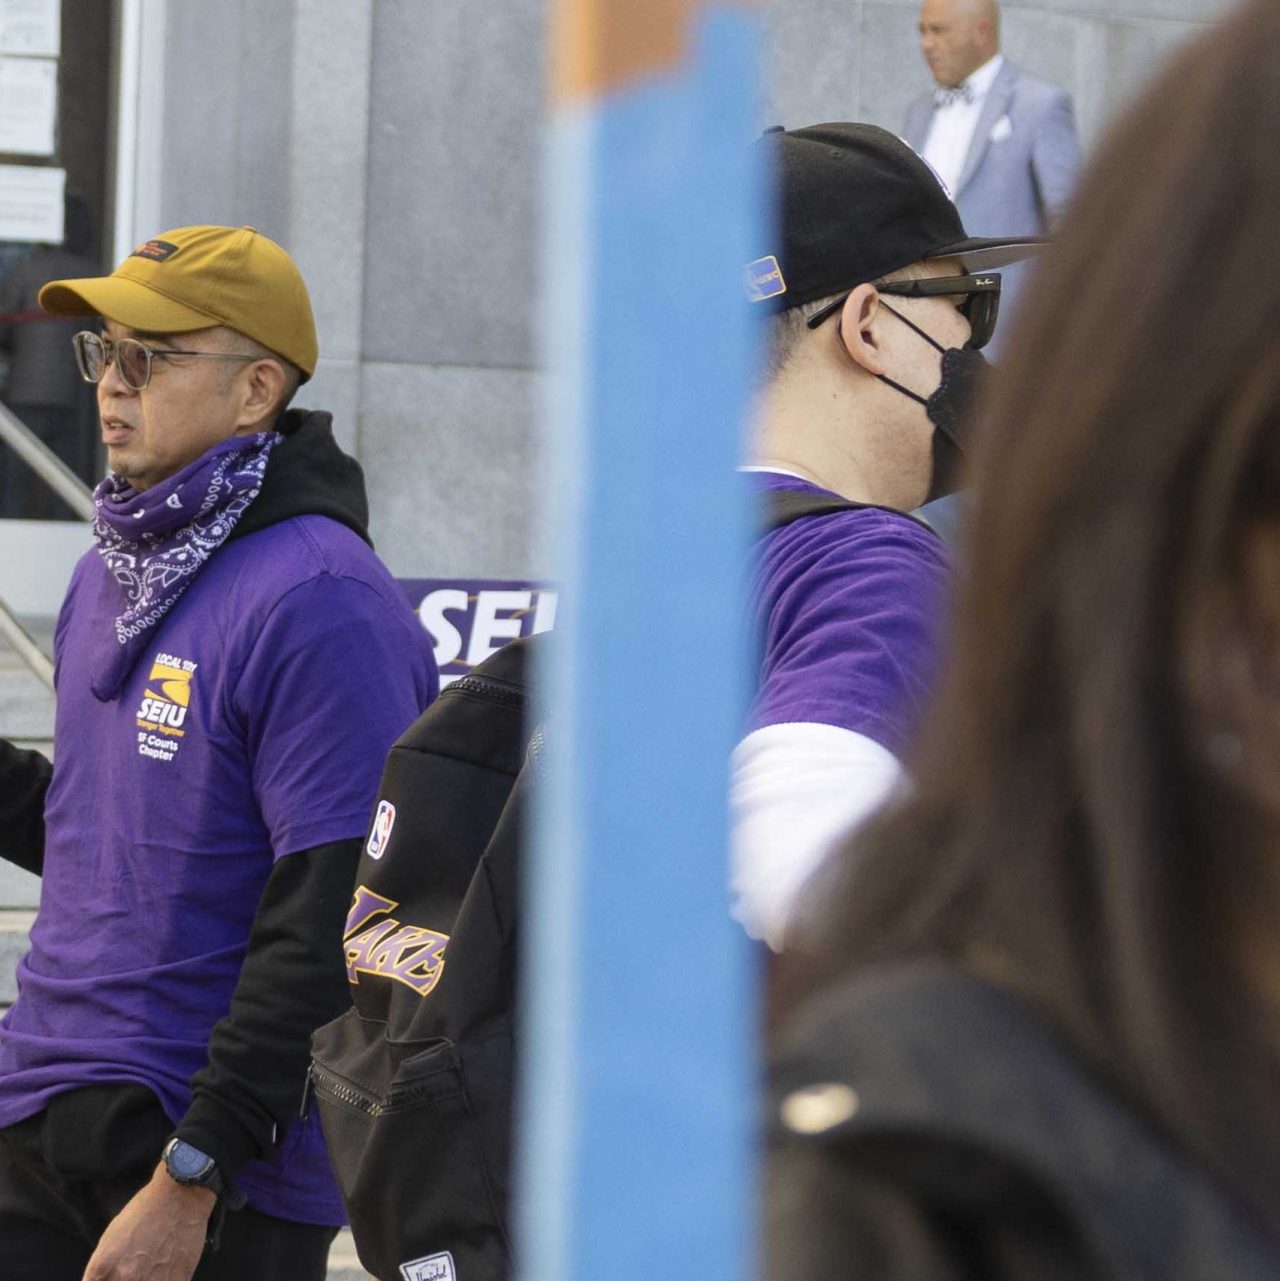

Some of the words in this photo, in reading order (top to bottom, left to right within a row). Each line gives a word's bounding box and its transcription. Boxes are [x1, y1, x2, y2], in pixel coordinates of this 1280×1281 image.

[419, 589, 558, 666] SEI
[155, 653, 182, 669] LOCAL
[136, 698, 187, 727] SEIU
[148, 735, 179, 751] Courts
[139, 744, 174, 761] Chapter
